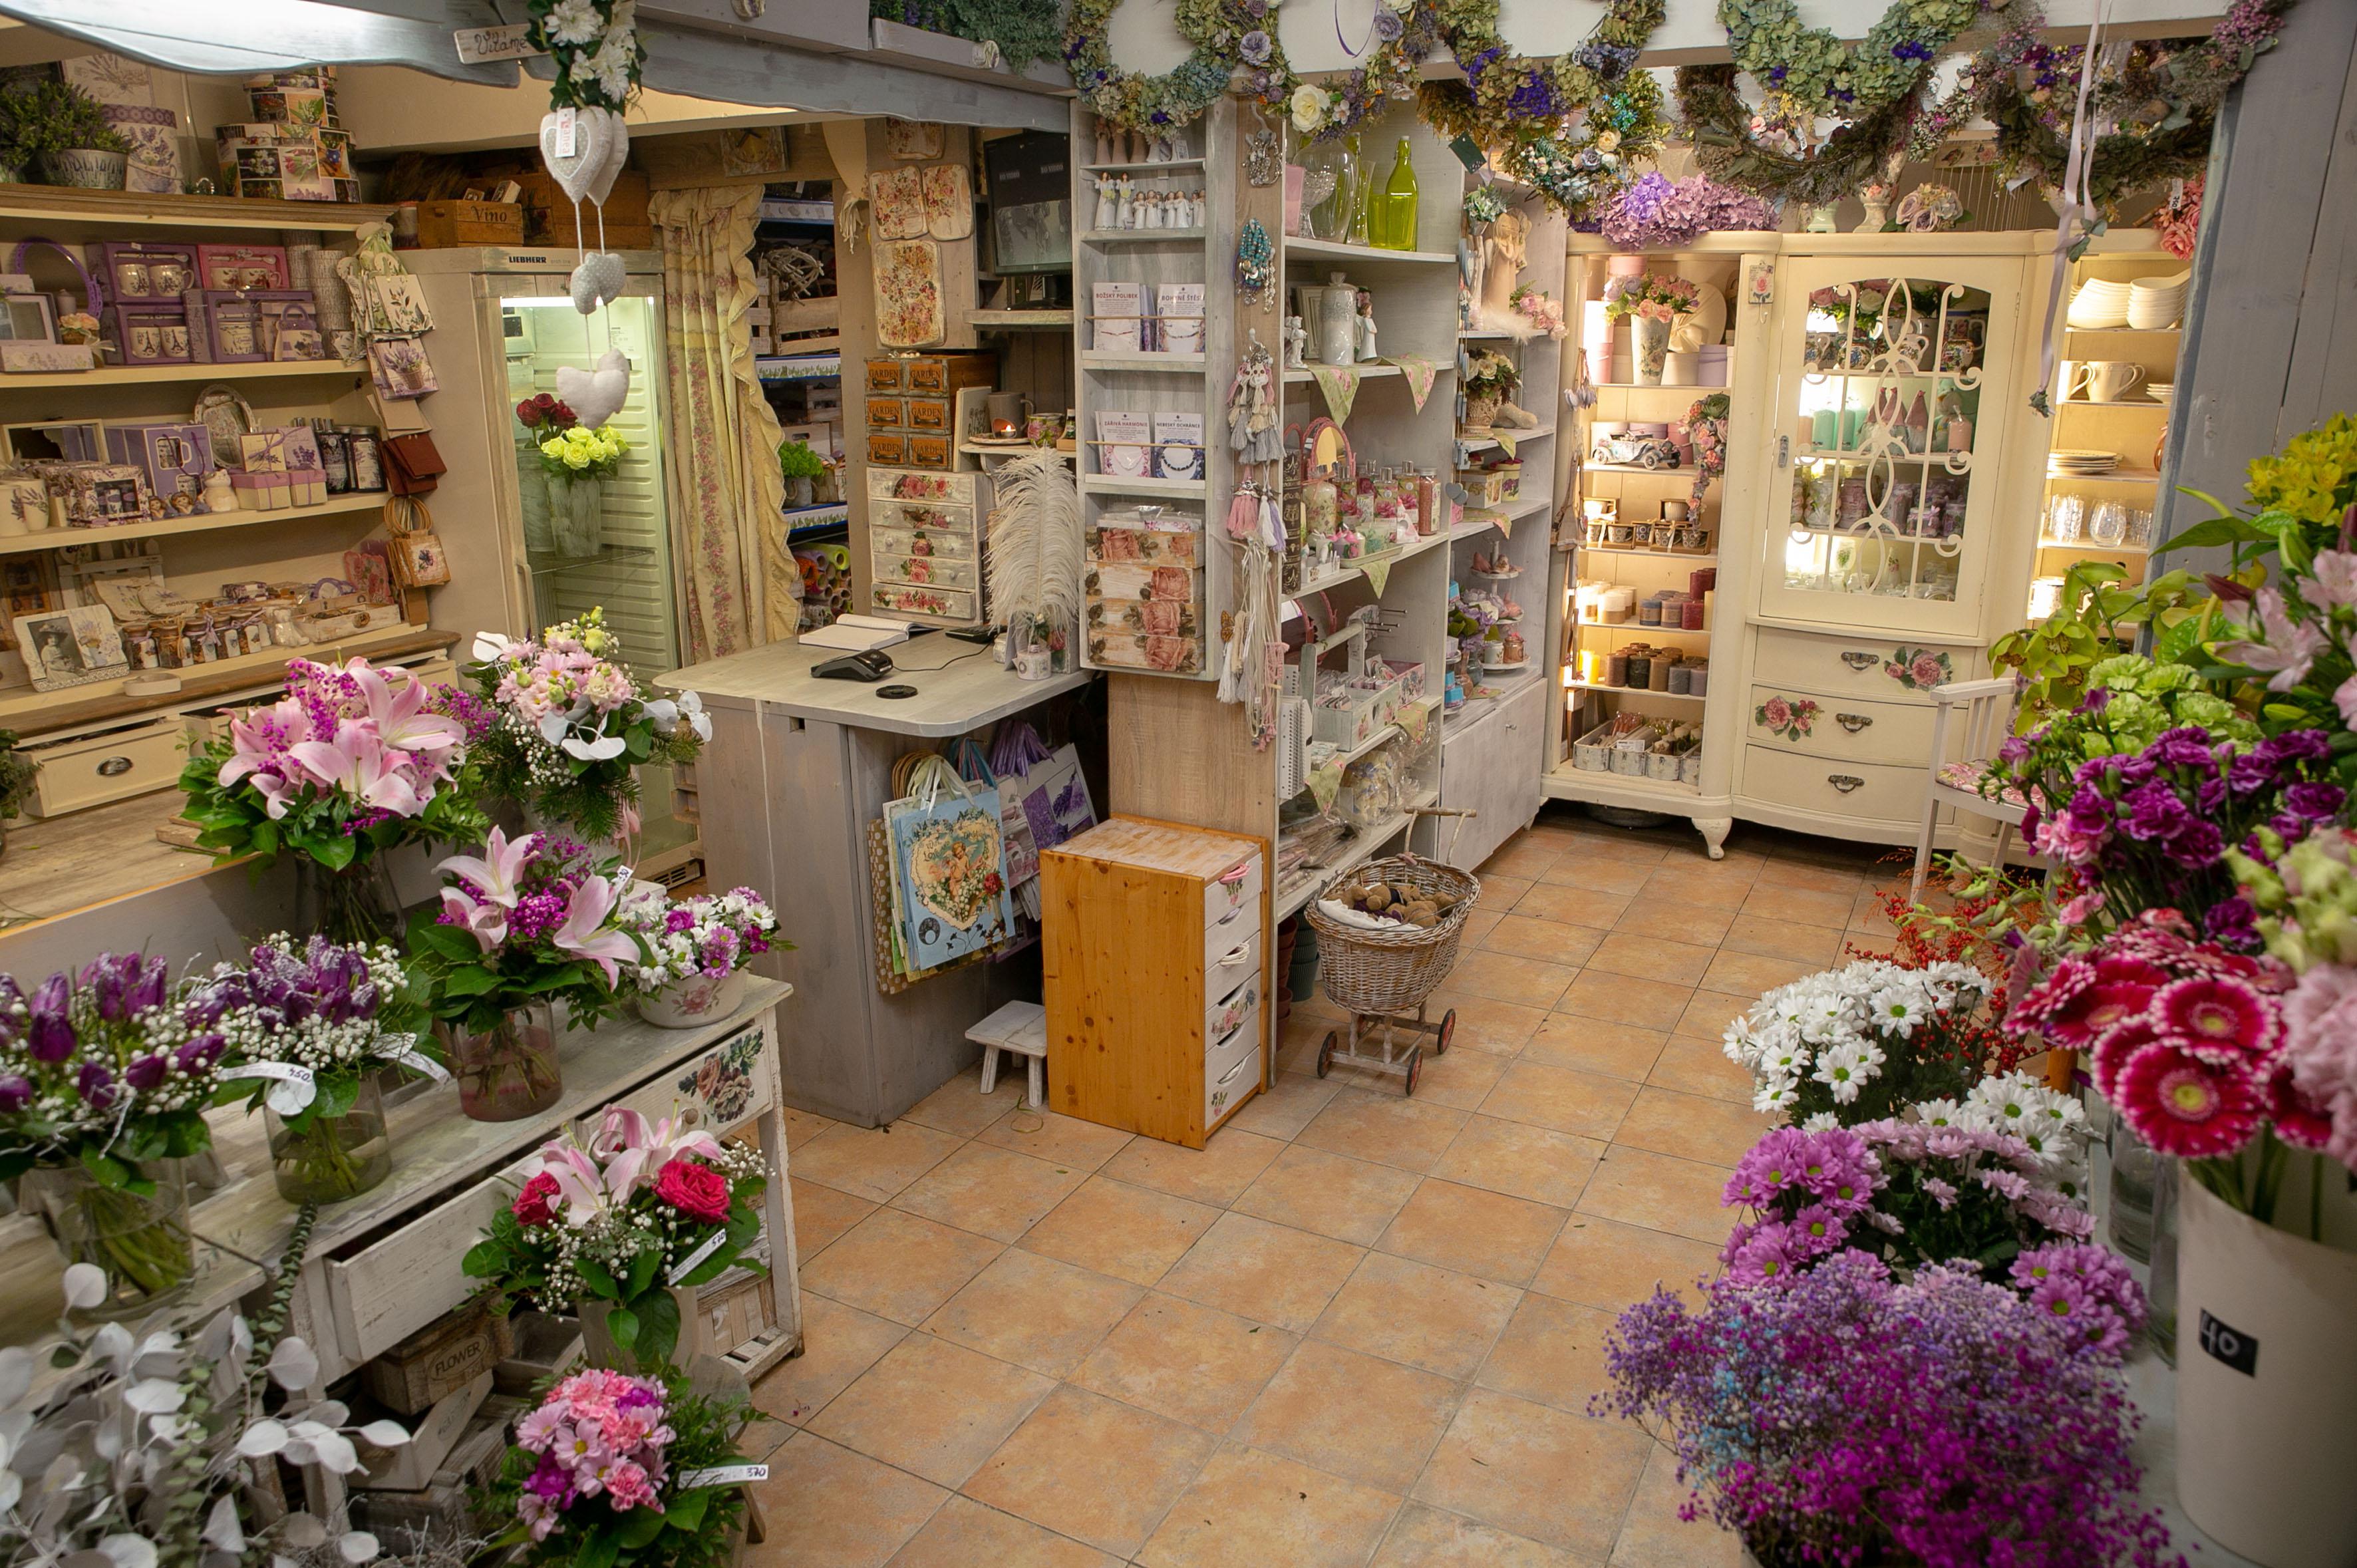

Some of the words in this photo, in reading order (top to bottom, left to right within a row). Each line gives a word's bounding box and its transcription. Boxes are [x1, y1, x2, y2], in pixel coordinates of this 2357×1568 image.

[470, 205, 508, 222] Vino
[869, 369, 898, 378] GARDEN
[910, 369, 941, 379] GARDEN
[869, 406, 899, 415] GARDEN
[911, 407, 942, 416] GARDEN
[871, 442, 901, 452] GARDEN
[914, 446, 945, 454] GARDEN
[712, 1231, 726, 1247] 570
[2201, 1313, 2241, 1356] 40
[435, 1342, 480, 1376] FLOWER
[746, 1467, 766, 1477] 370
